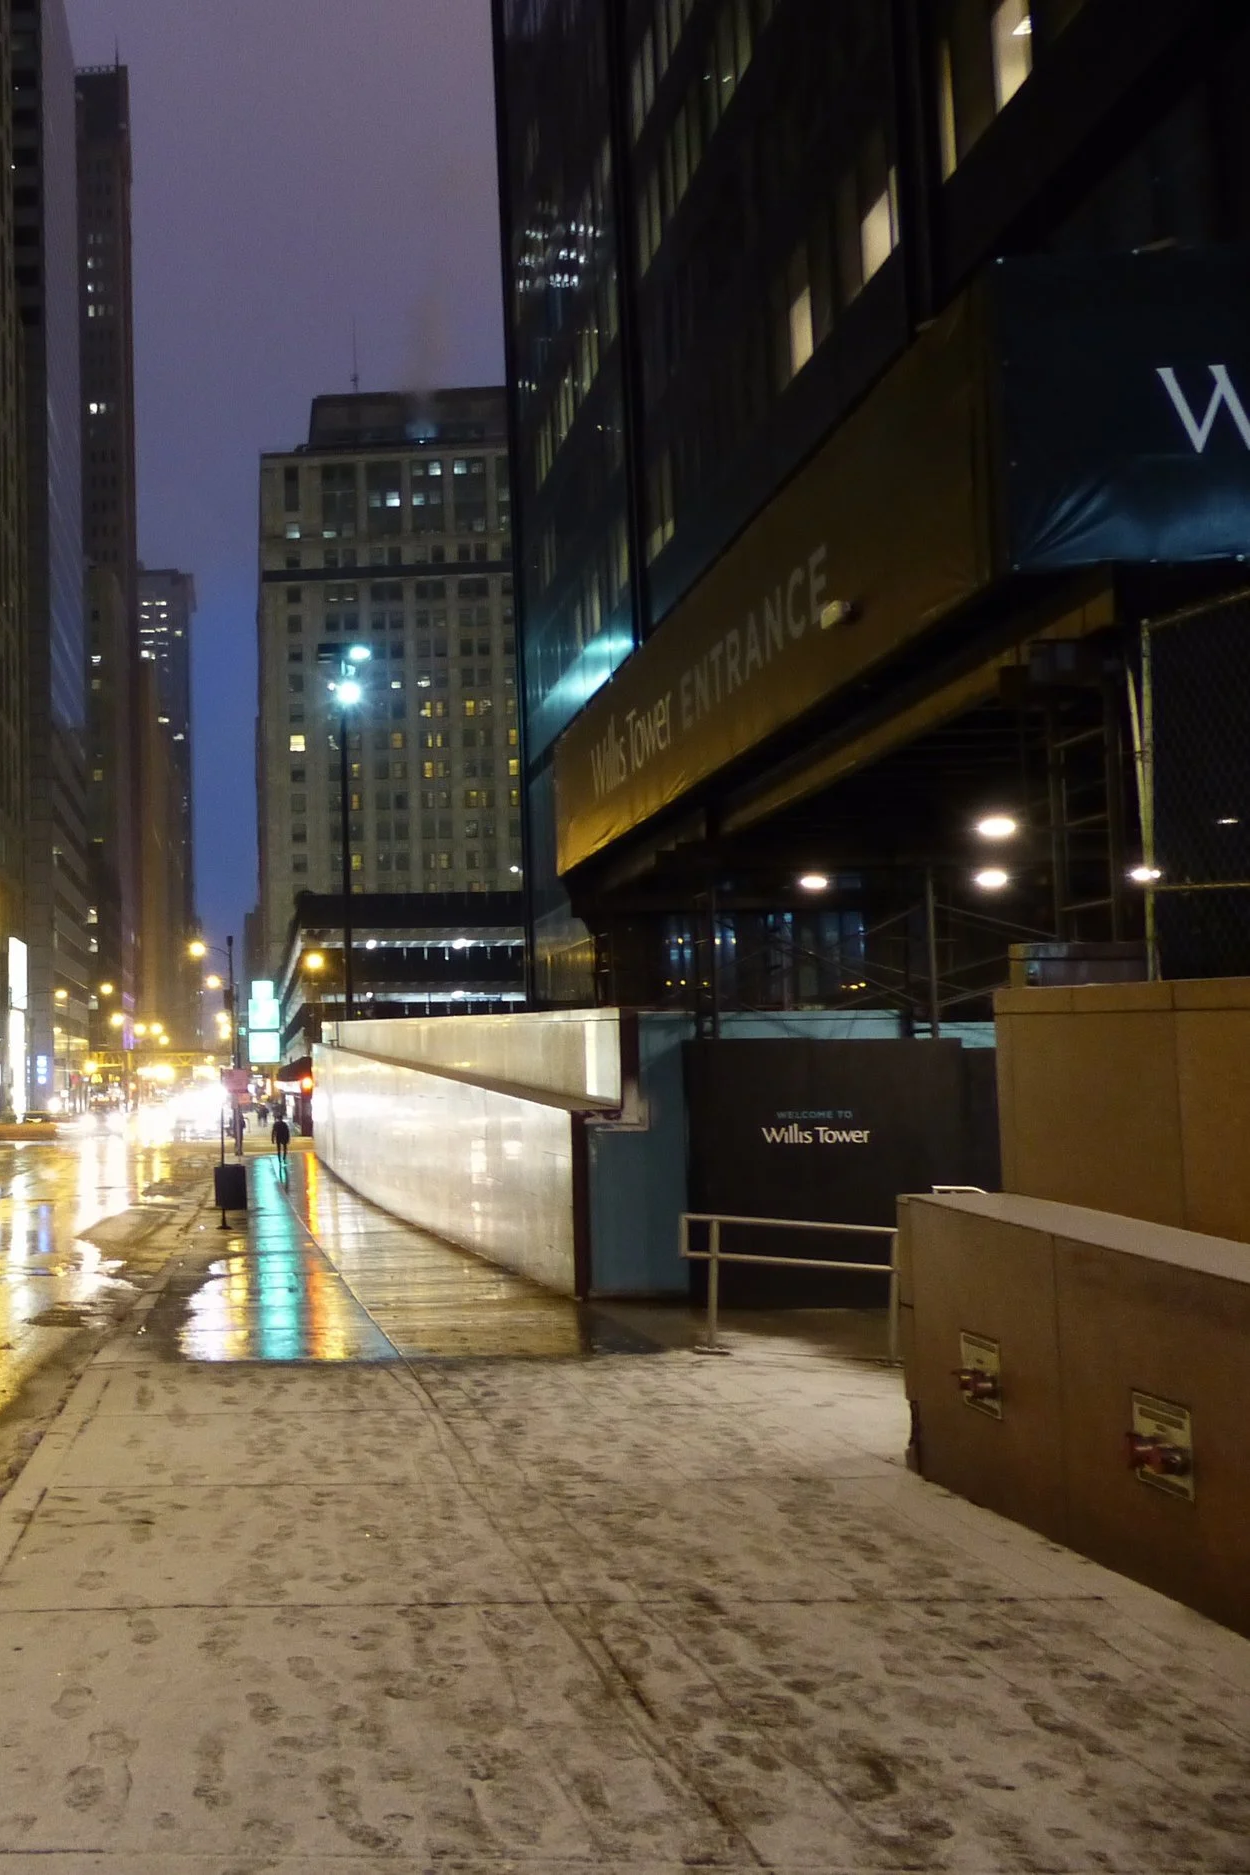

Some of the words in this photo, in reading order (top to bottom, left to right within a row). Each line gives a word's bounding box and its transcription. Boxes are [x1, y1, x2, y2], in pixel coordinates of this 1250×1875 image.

[591, 715, 627, 799] Willis
[626, 690, 672, 776] Tower
[680, 544, 828, 730] ENTRANCE
[776, 1110, 834, 1119] WELCOME
[837, 1110, 853, 1119] TO
[761, 1123, 813, 1144] Willis
[814, 1126, 871, 1144] Tower
